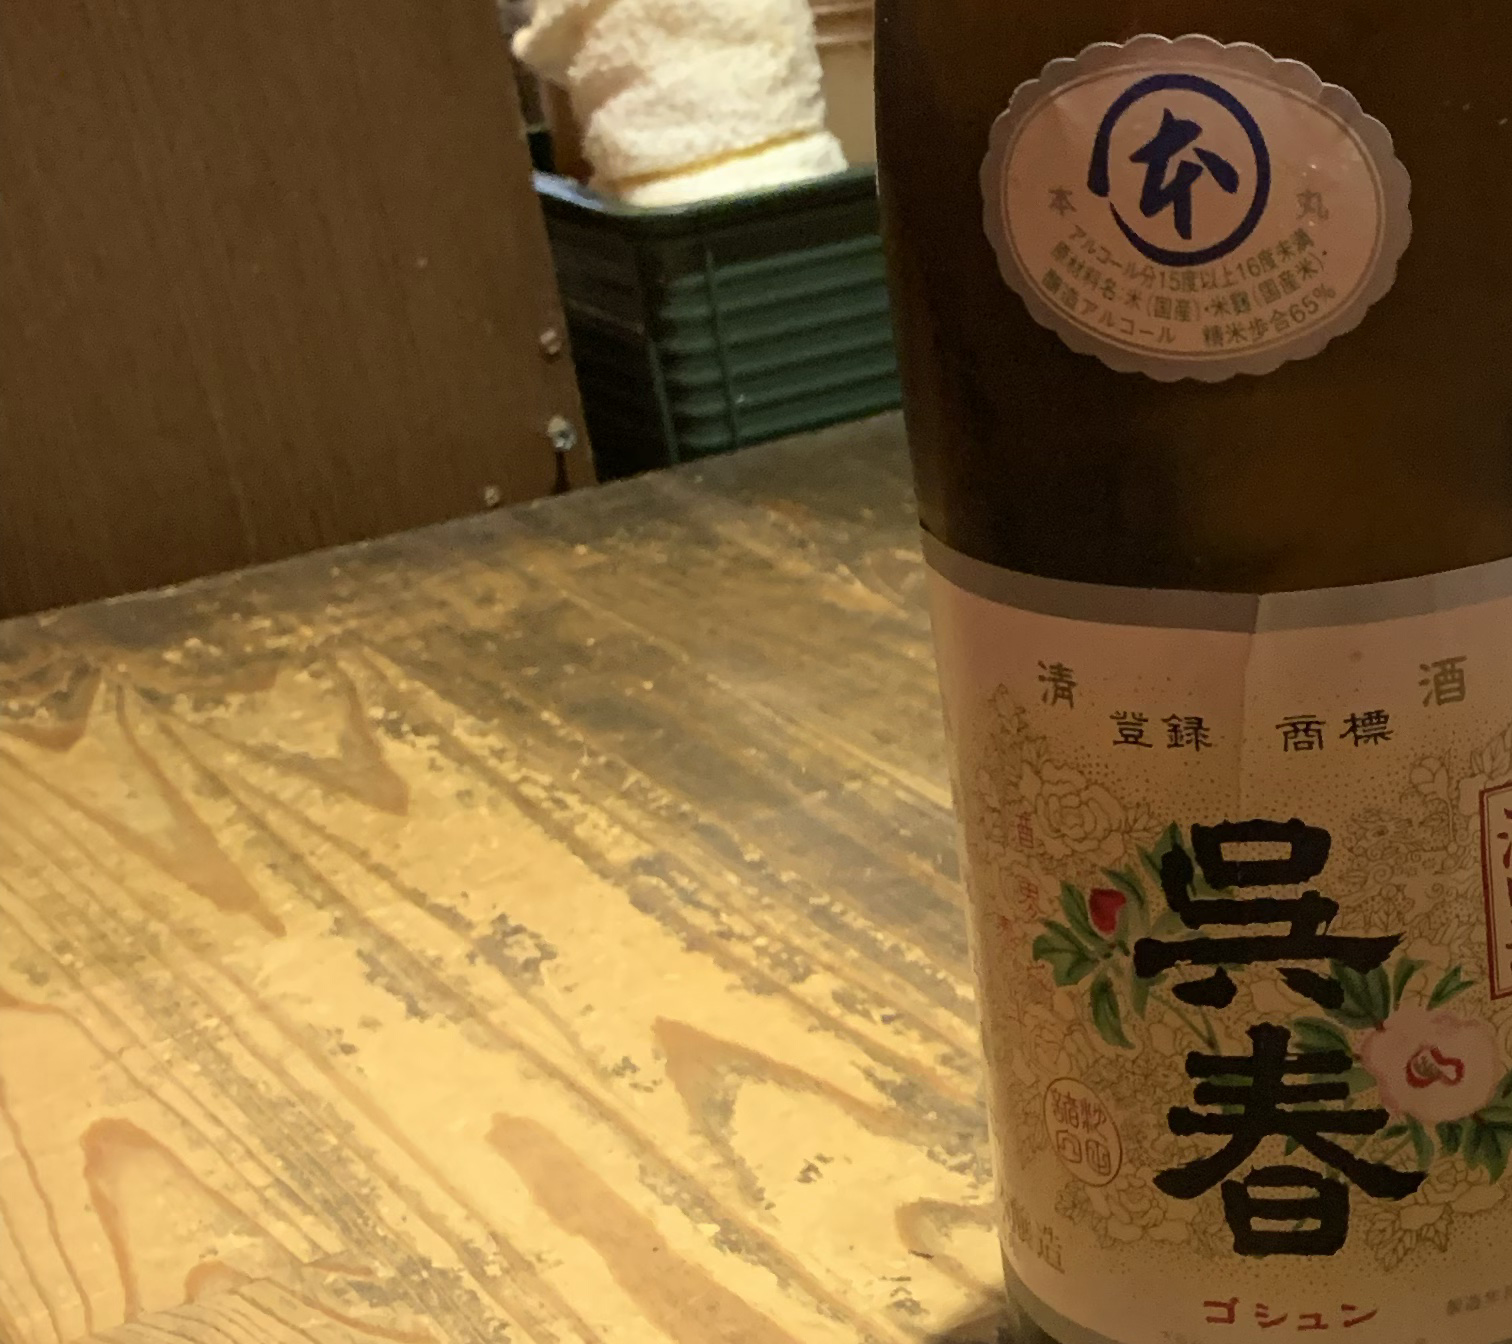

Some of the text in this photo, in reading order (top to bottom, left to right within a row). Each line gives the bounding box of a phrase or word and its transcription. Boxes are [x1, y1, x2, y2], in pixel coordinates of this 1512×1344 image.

[1417, 655, 1468, 708] 酒
[1274, 709, 1394, 753] 商標
[1203, 1296, 1379, 1330] ゴシュン
